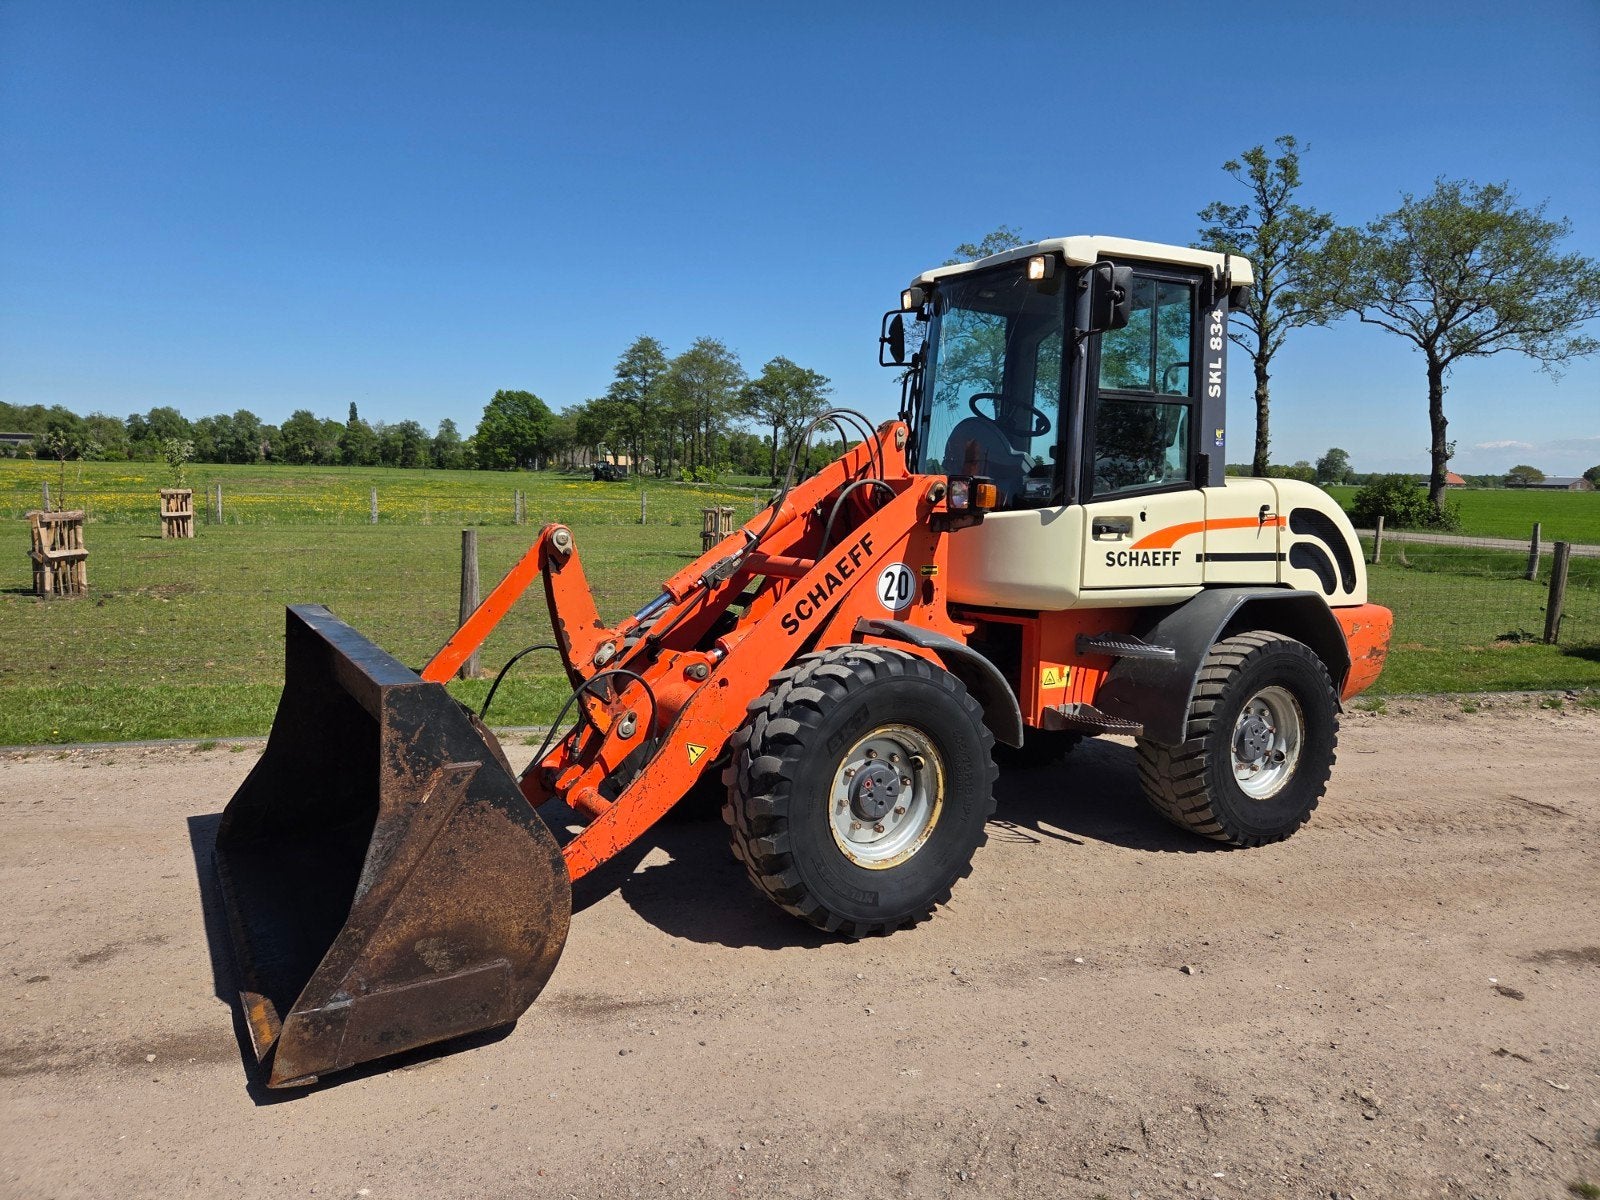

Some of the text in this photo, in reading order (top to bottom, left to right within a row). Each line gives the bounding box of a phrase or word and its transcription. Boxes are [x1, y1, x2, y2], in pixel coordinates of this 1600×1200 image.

[1208, 309, 1223, 398] SKL 834
[781, 532, 874, 635] SCHAEFF
[884, 571, 909, 601] 20
[1105, 551, 1181, 567] SCHAEFF
